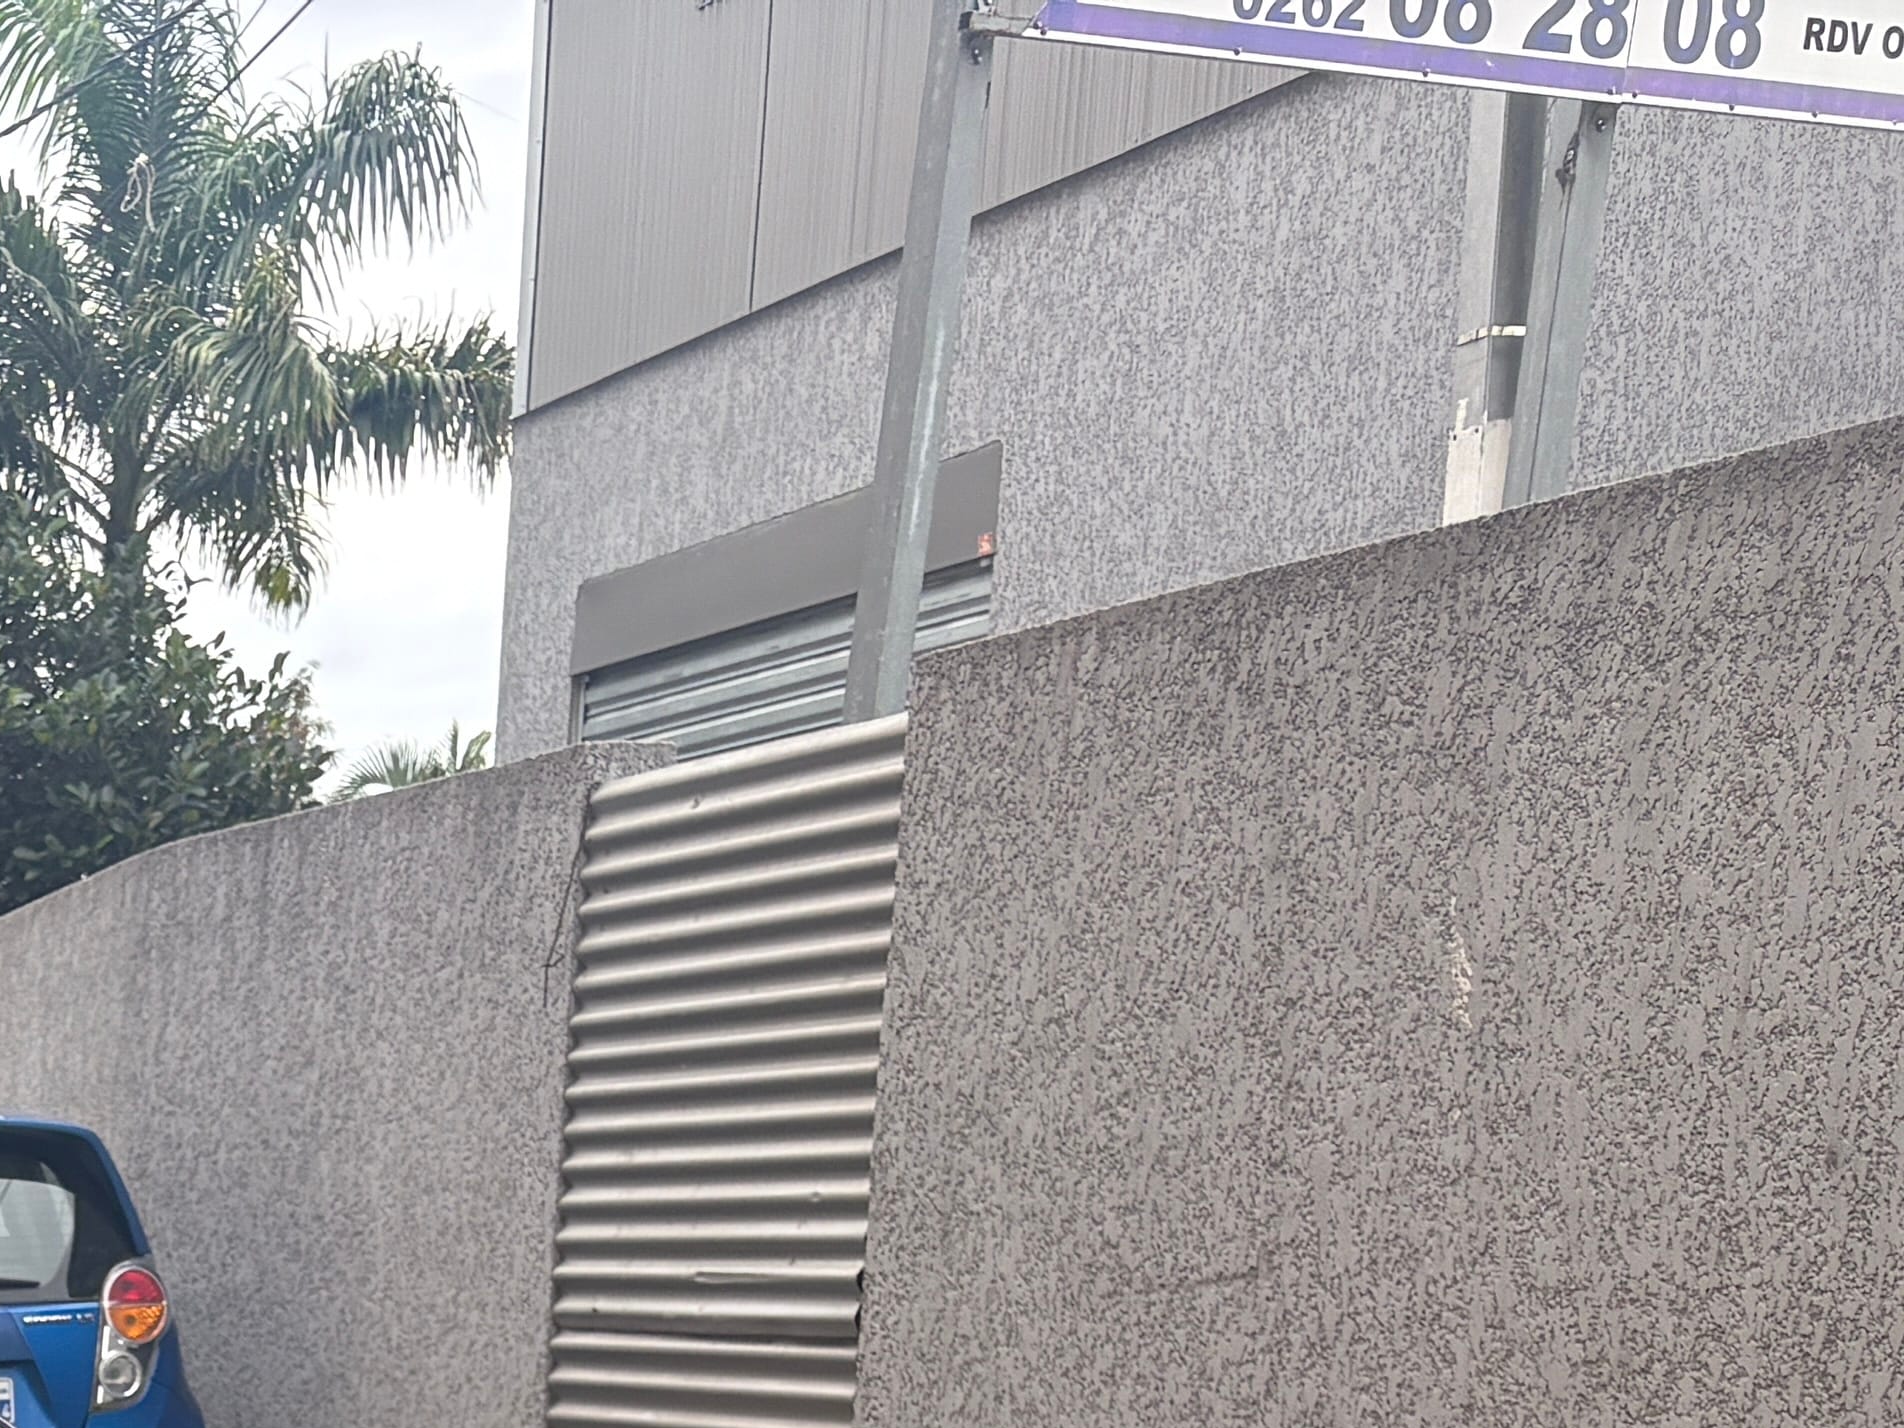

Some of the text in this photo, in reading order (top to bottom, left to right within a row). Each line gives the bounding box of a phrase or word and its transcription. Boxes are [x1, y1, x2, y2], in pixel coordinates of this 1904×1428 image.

[1522, 0, 1628, 59] 28
[1663, 0, 1765, 69] 08
[1802, 17, 1874, 56] RDV
